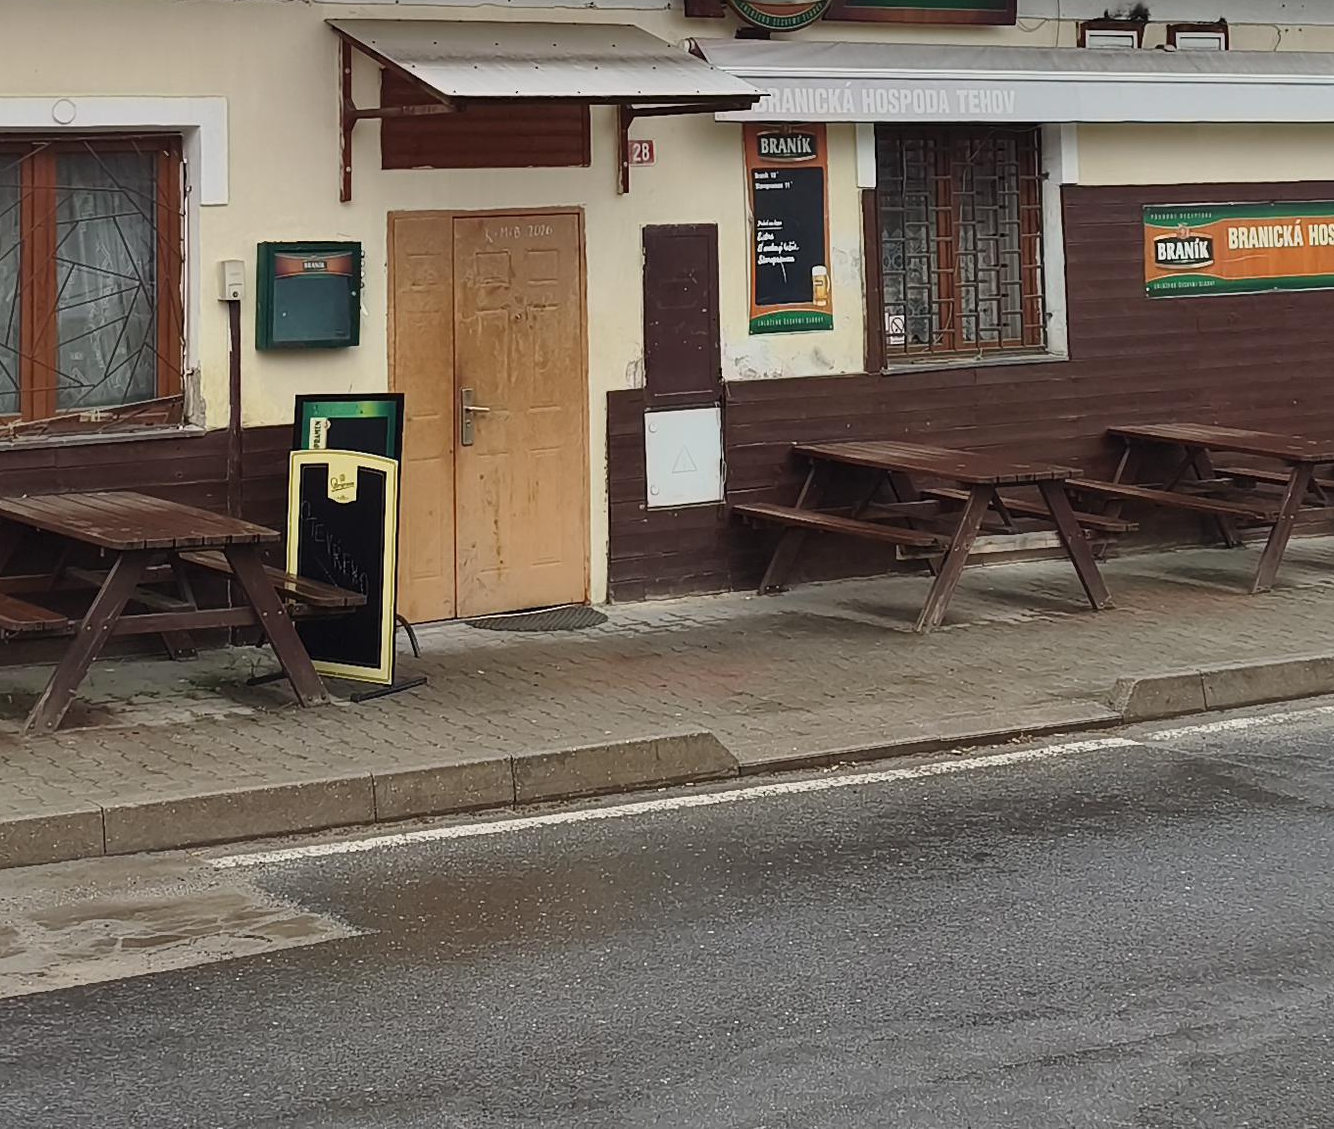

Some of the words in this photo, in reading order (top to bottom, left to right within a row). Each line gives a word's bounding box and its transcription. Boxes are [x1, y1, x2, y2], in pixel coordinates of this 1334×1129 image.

[862, 88, 951, 114] HOSPODA
[956, 89, 1016, 115] TEHOV
[633, 142, 650, 162] 28
[760, 134, 812, 154] BRANÍK
[1228, 219, 1304, 250] BRANICKÁ
[1157, 237, 1210, 261] BRANÍK
